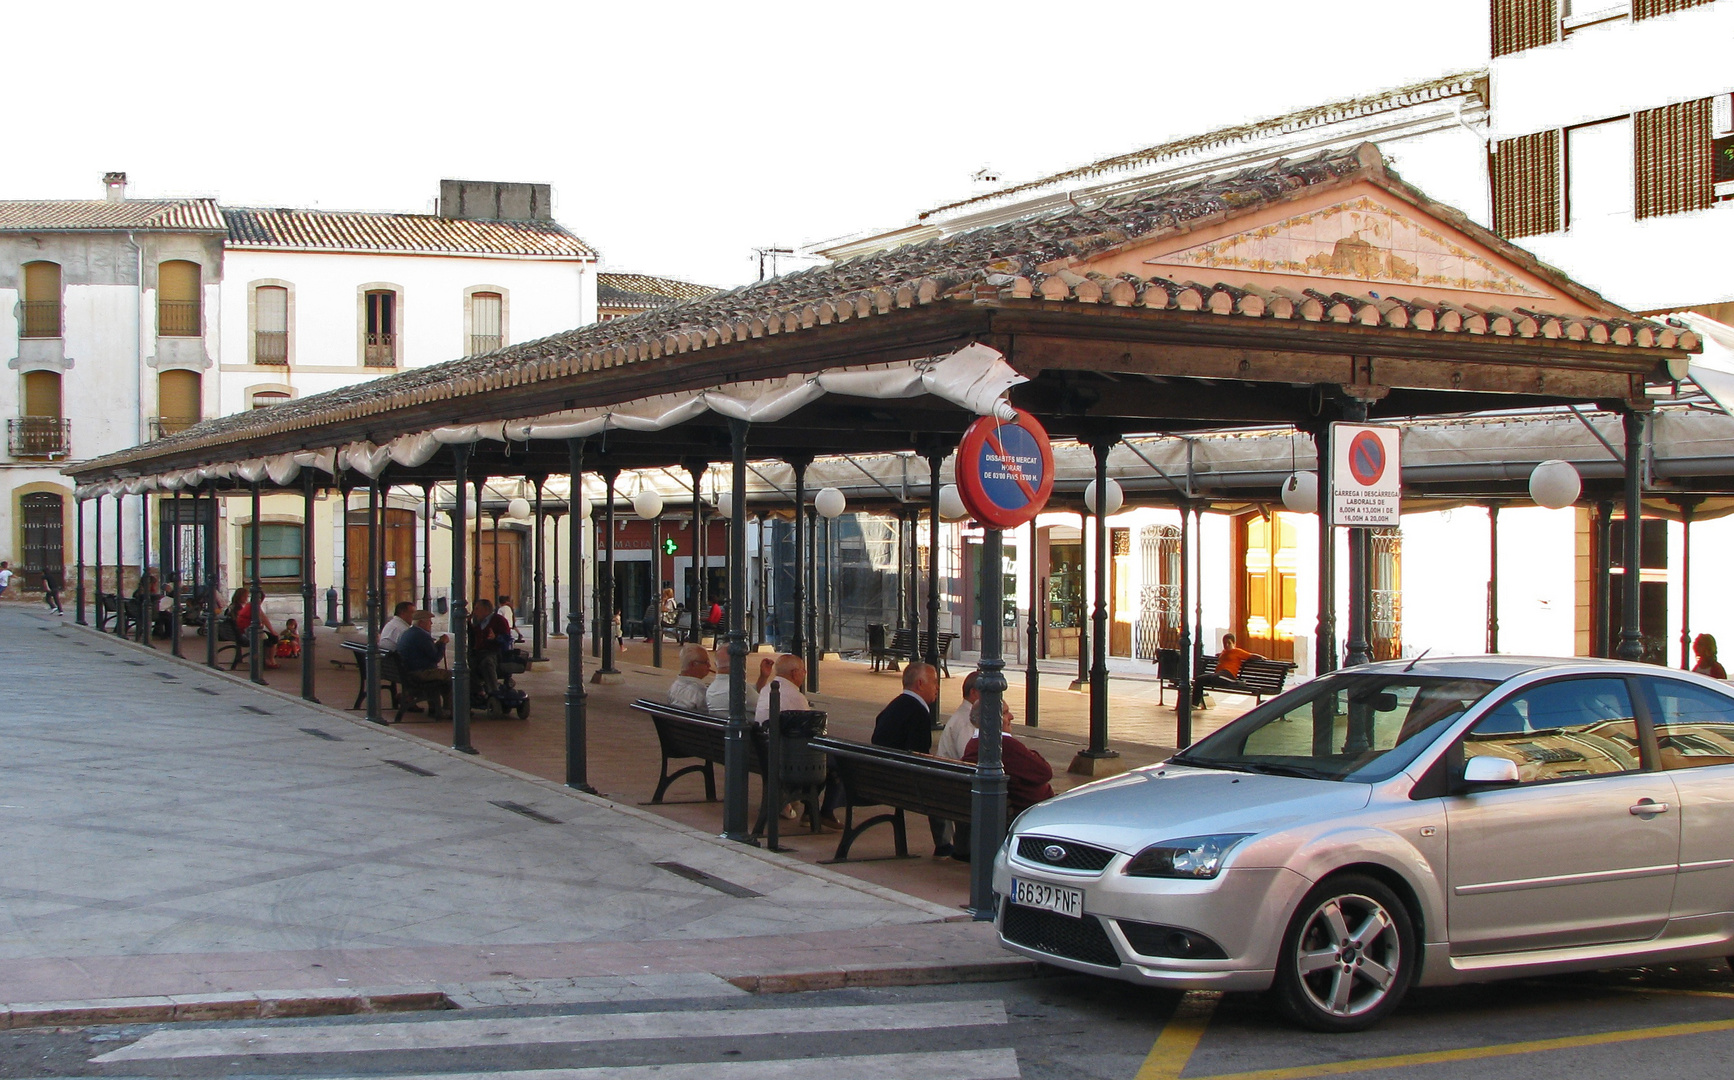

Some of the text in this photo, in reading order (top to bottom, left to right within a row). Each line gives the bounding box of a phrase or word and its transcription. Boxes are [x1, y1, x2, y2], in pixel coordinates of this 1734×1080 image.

[1016, 456, 1037, 464] MERCAT
[596, 540, 651, 548] AMACIA
[1018, 882, 1078, 912] 6637 FNF
